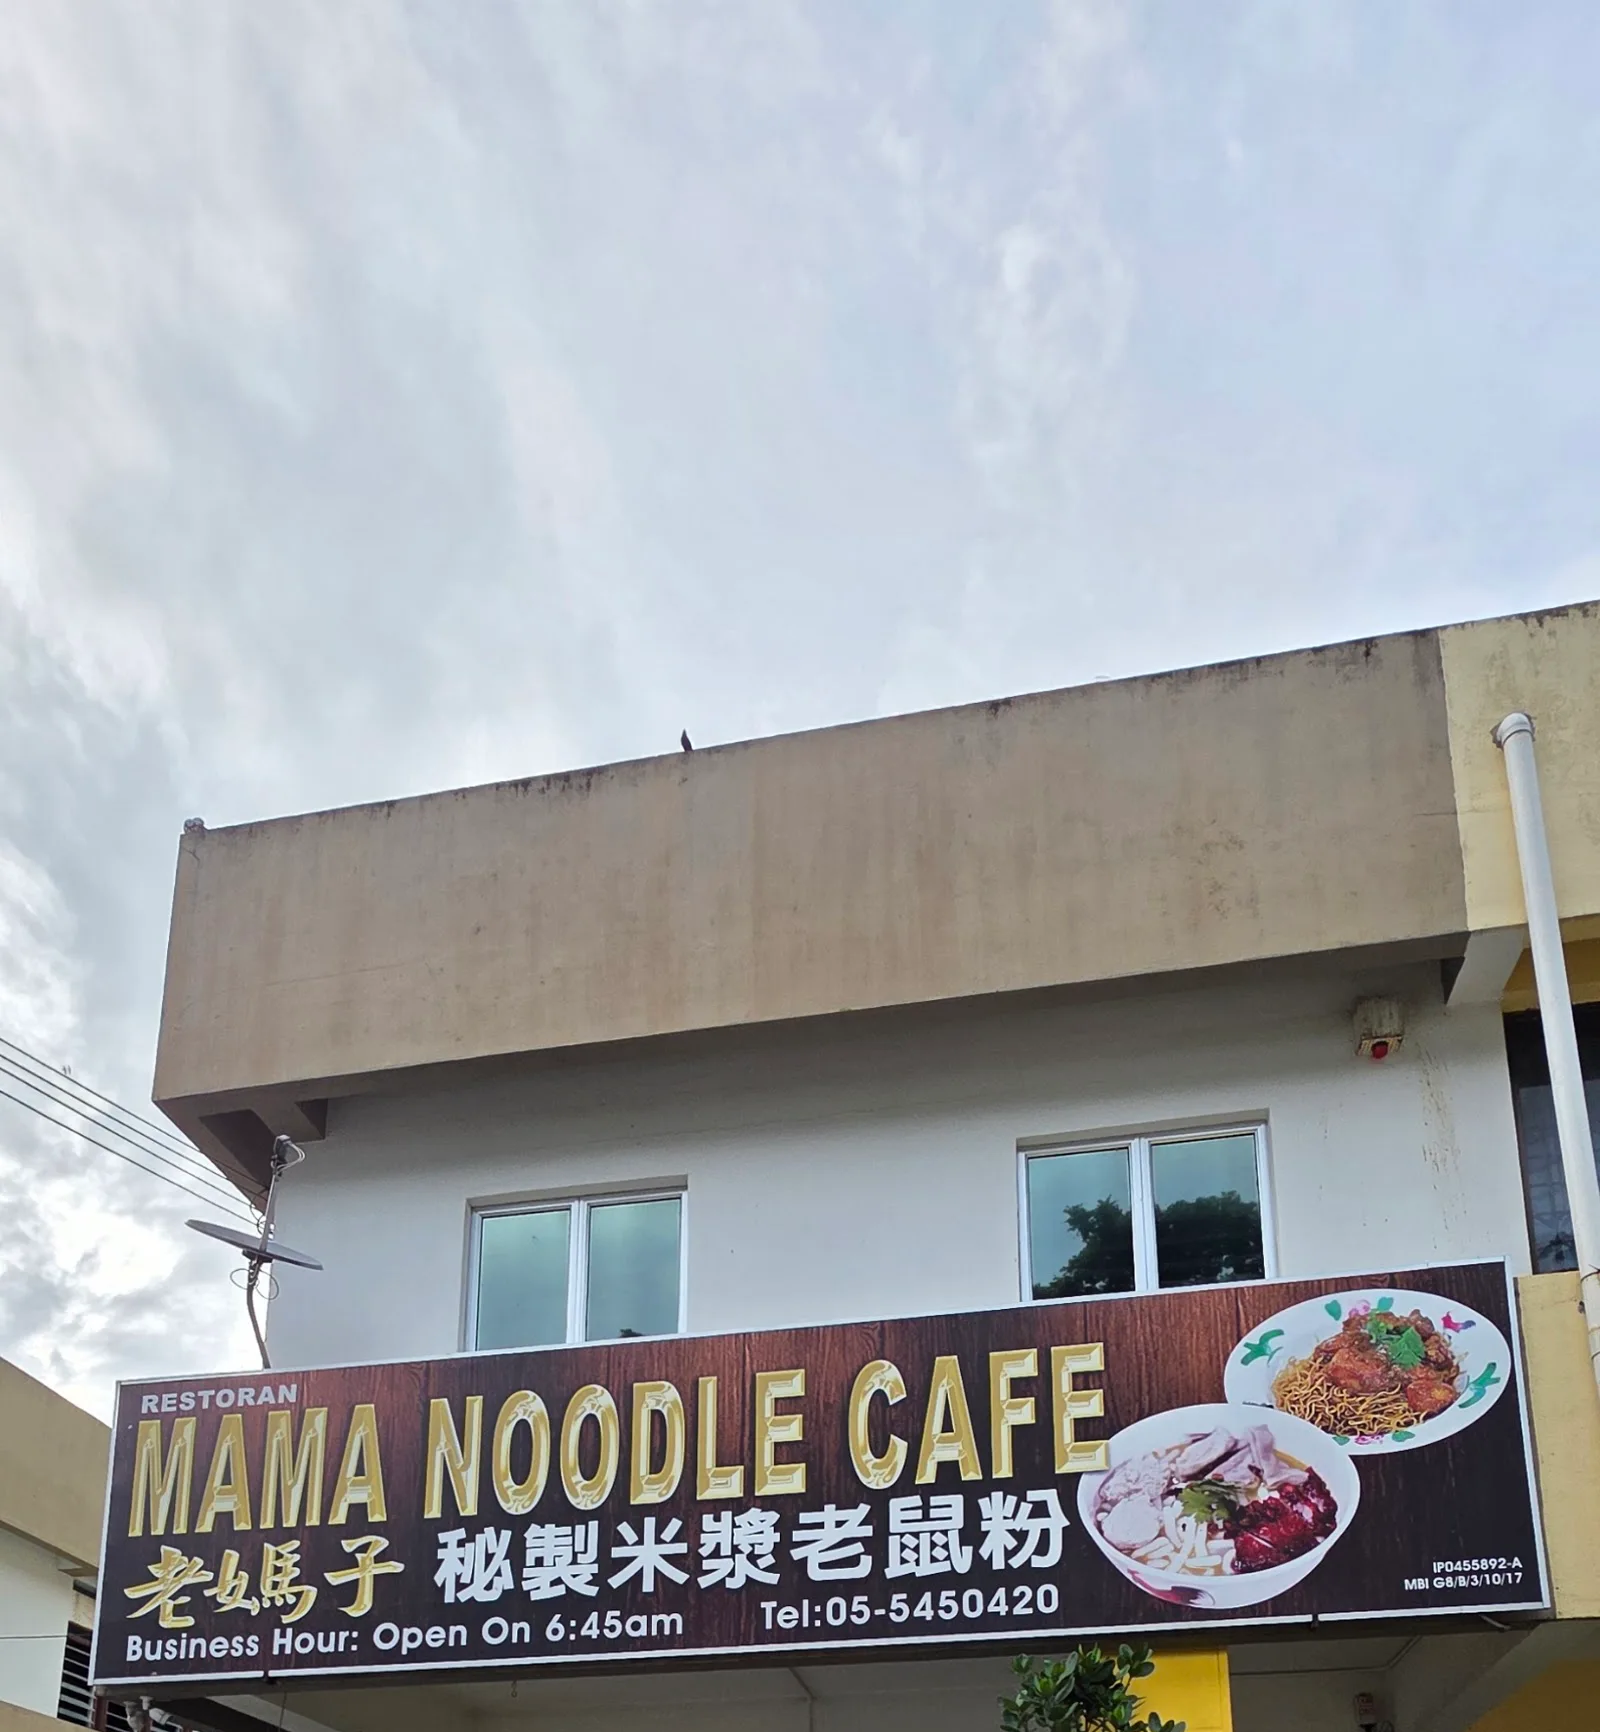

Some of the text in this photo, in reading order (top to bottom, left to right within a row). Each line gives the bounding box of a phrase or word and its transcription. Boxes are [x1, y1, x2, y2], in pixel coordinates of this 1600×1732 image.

[141, 1383, 298, 1414] RESTORAN
[128, 1341, 1110, 1537] MAMA NOODLE CAFE
[433, 1488, 1071, 1603] 秘製米漿老鼠粉
[1432, 1556, 1523, 1574] IP0455892-A
[123, 1535, 405, 1630] 老媽子
[1404, 1572, 1523, 1591] MBI G8/B/3/10/17
[760, 1583, 1060, 1631] Tel:05-5450420
[126, 1609, 683, 1662] Business Hour: Open On 6:45am
